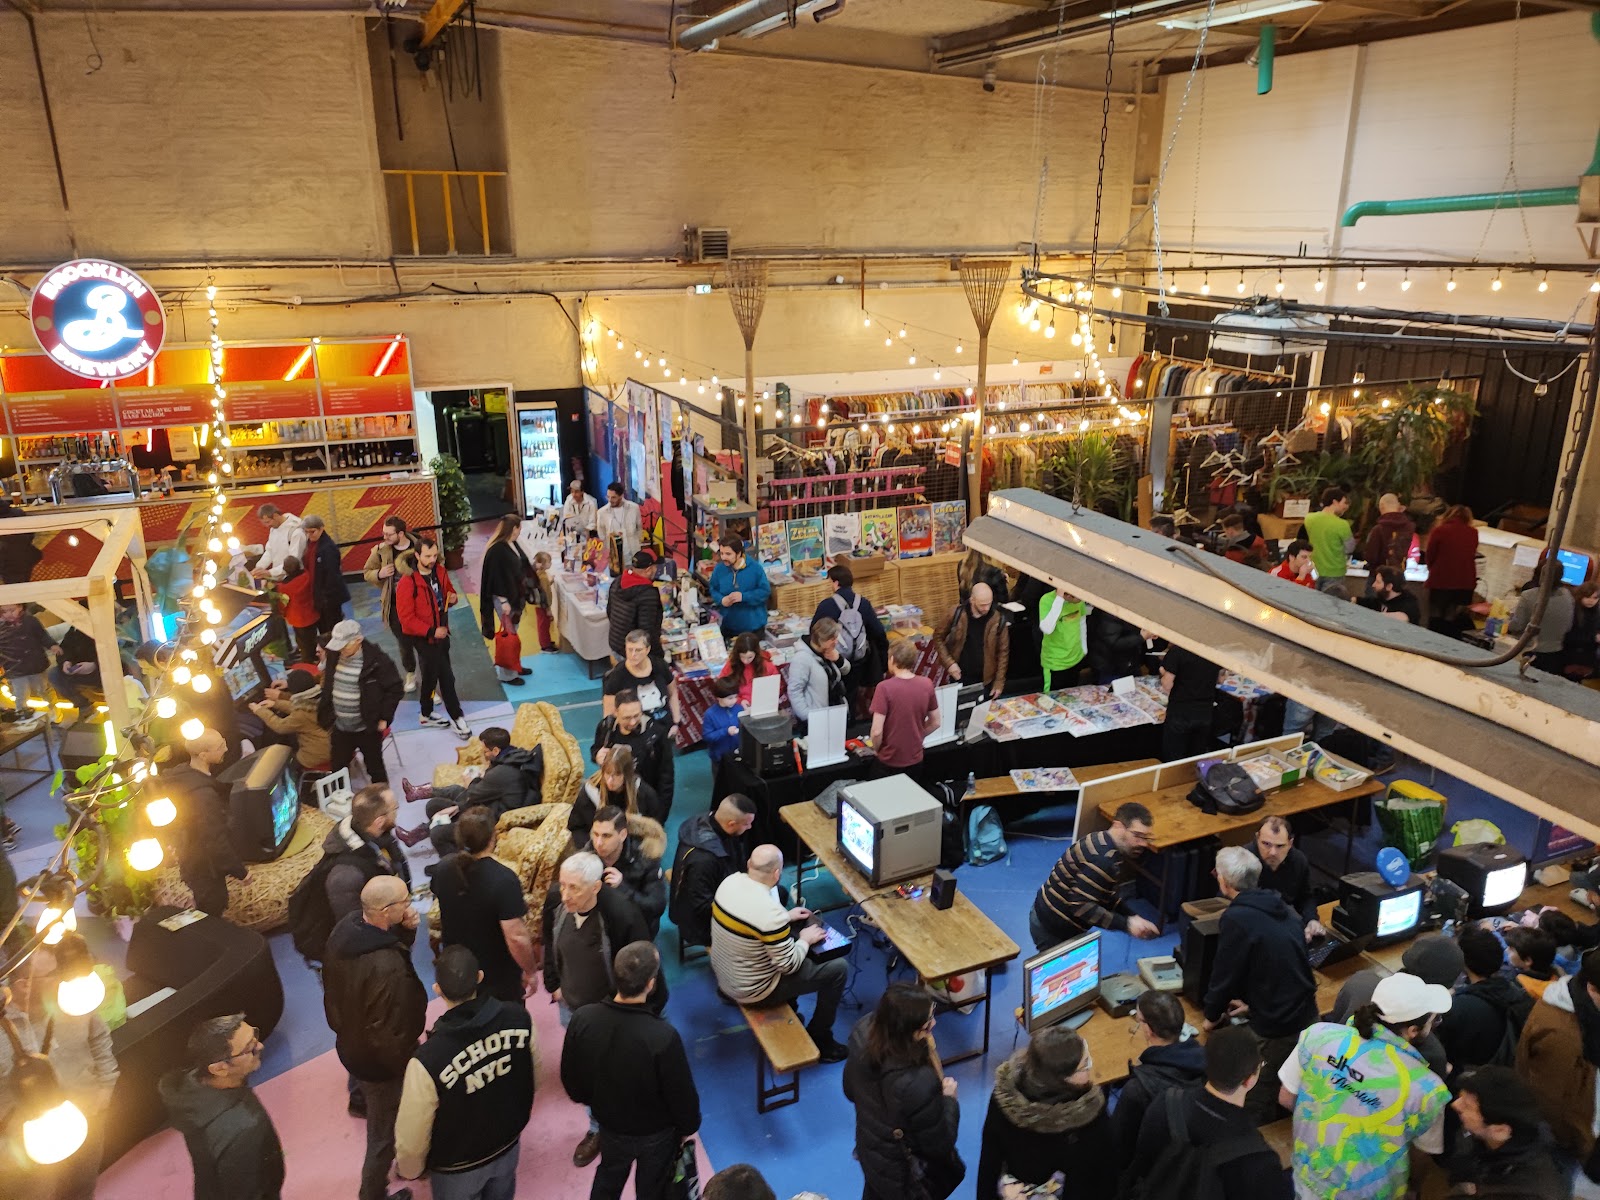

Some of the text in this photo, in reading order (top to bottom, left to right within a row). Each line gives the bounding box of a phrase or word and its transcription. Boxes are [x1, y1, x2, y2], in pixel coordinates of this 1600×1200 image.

[40, 262, 148, 300] BROOKLYN
[51, 340, 155, 376] BREWERY
[439, 1029, 530, 1090] SCHOTT
[465, 1054, 512, 1095] NYC
